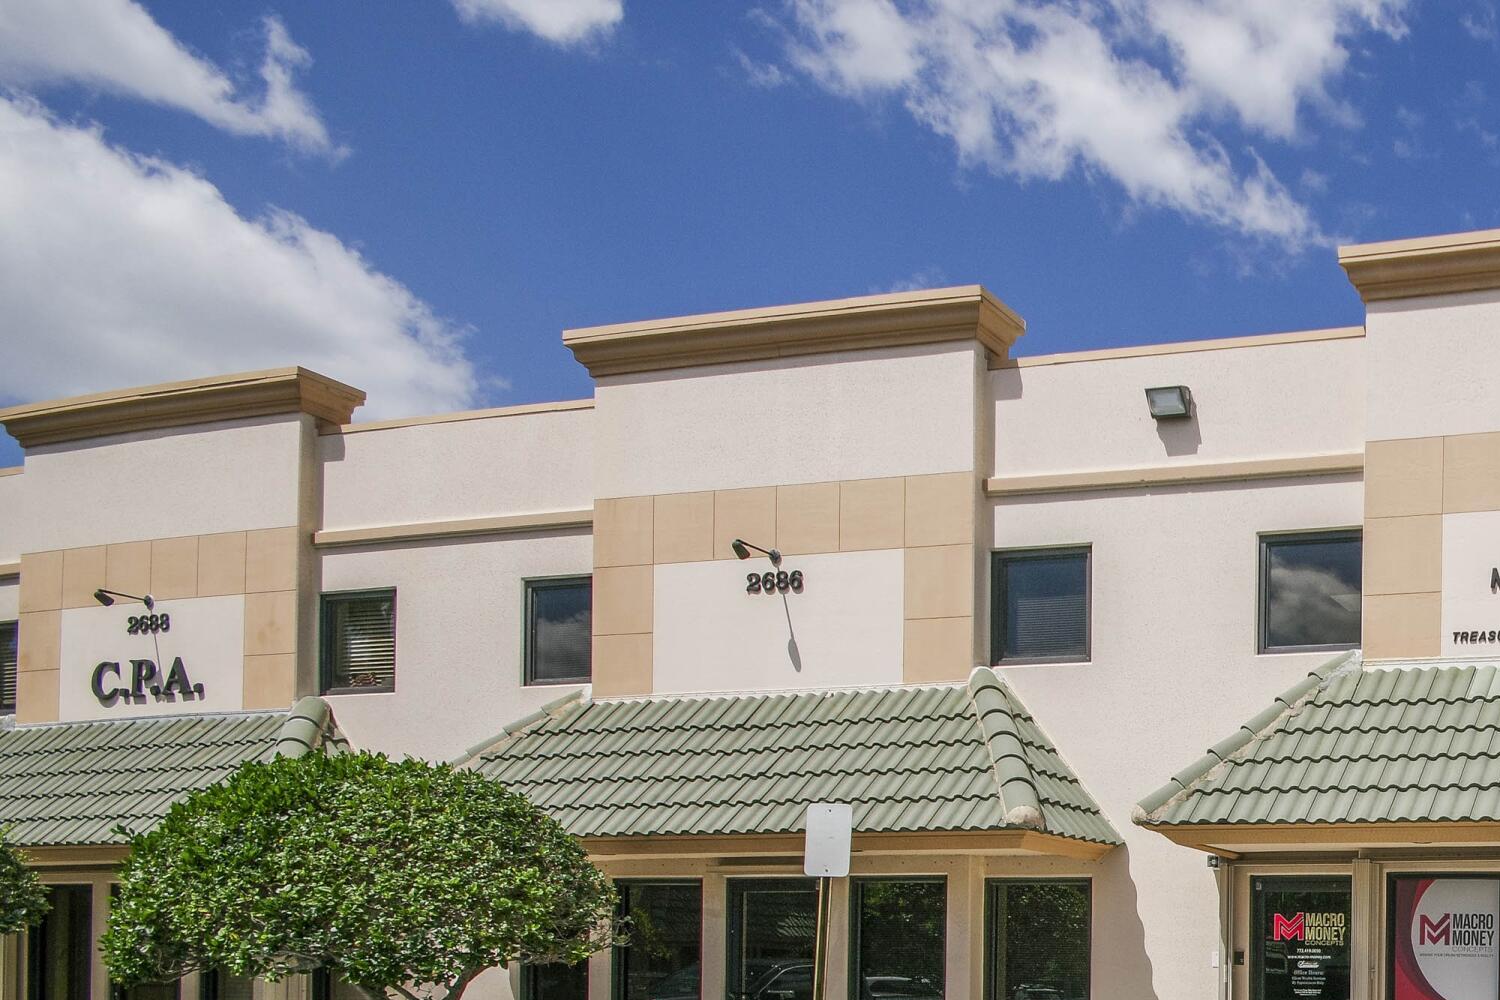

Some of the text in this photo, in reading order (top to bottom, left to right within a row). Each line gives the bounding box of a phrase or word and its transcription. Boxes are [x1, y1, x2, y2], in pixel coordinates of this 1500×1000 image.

[746, 570, 803, 592] 2686
[127, 613, 170, 634] 2688
[91, 656, 205, 701] C.P.A.
[1305, 912, 1345, 927] MACRO
[1452, 913, 1494, 930] MACRO
[1305, 926, 1346, 941] MONEY
[1452, 930, 1494, 946] MONEY
